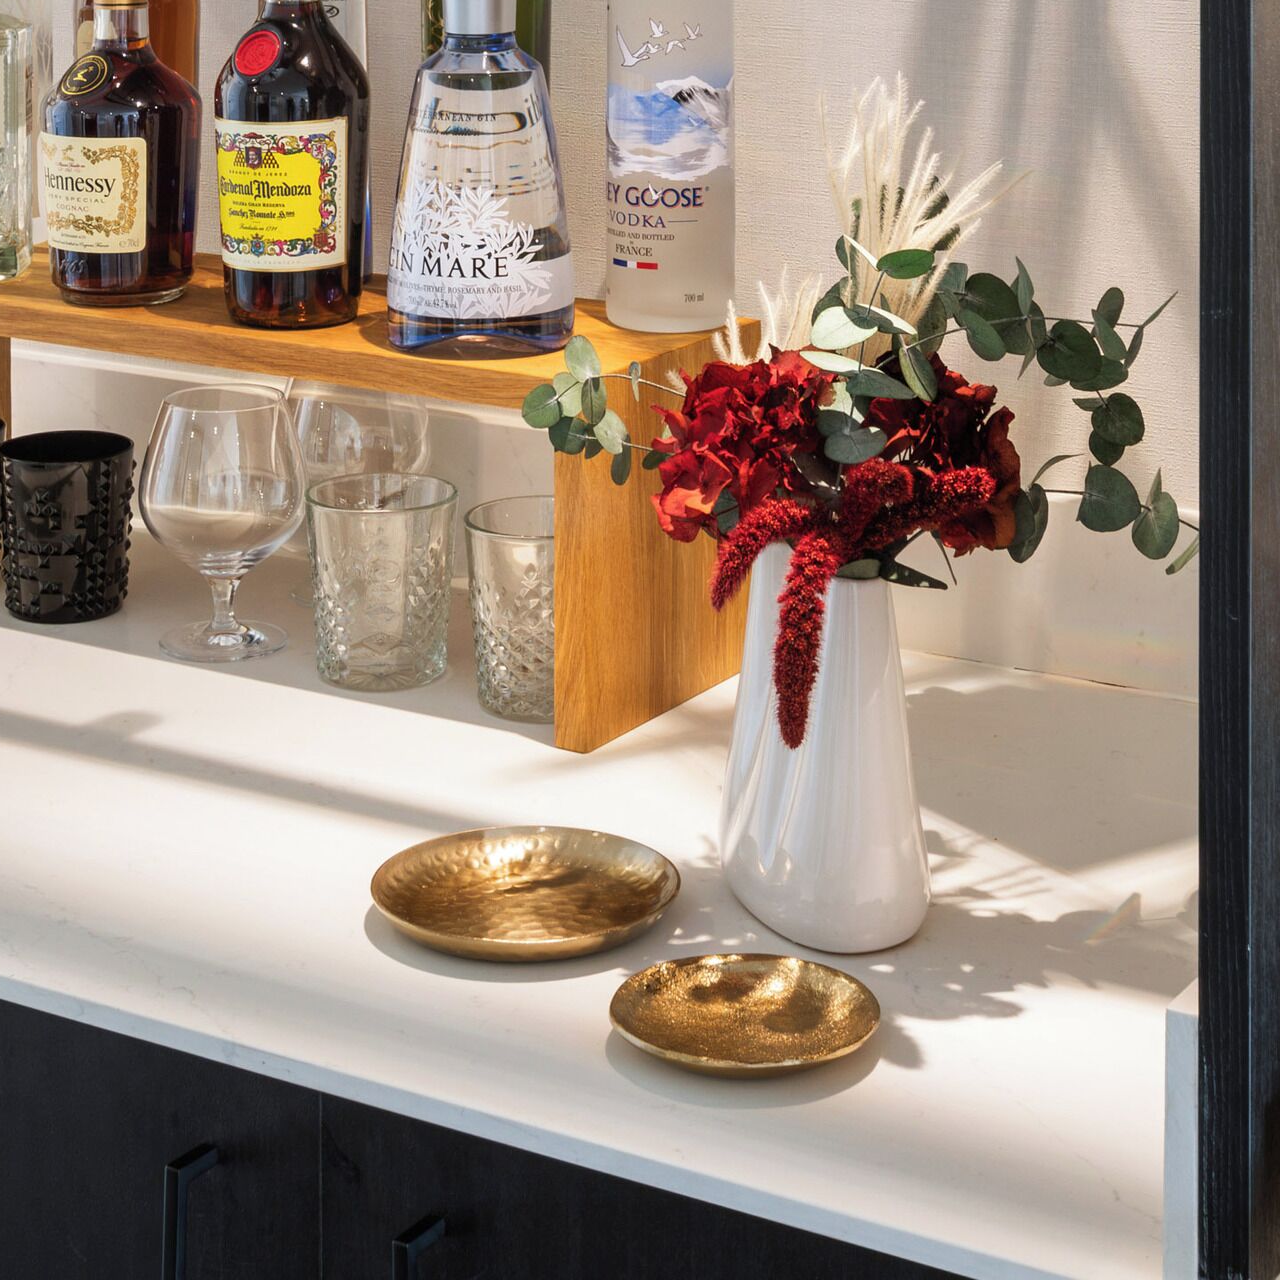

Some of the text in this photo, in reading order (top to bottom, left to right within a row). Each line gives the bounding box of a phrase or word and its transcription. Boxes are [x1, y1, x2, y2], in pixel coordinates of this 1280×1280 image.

[477, 114, 496, 122] GIN
[44, 166, 116, 198] Hennessy
[220, 176, 312, 200] Cardenal Mendoza
[608, 182, 704, 208] EY GOOSE
[56, 203, 88, 212] COGNAC
[610, 210, 666, 228] VODKA
[616, 244, 652, 256] FRANCE
[388, 246, 414, 272] GIN
[421, 256, 509, 280] MARE
